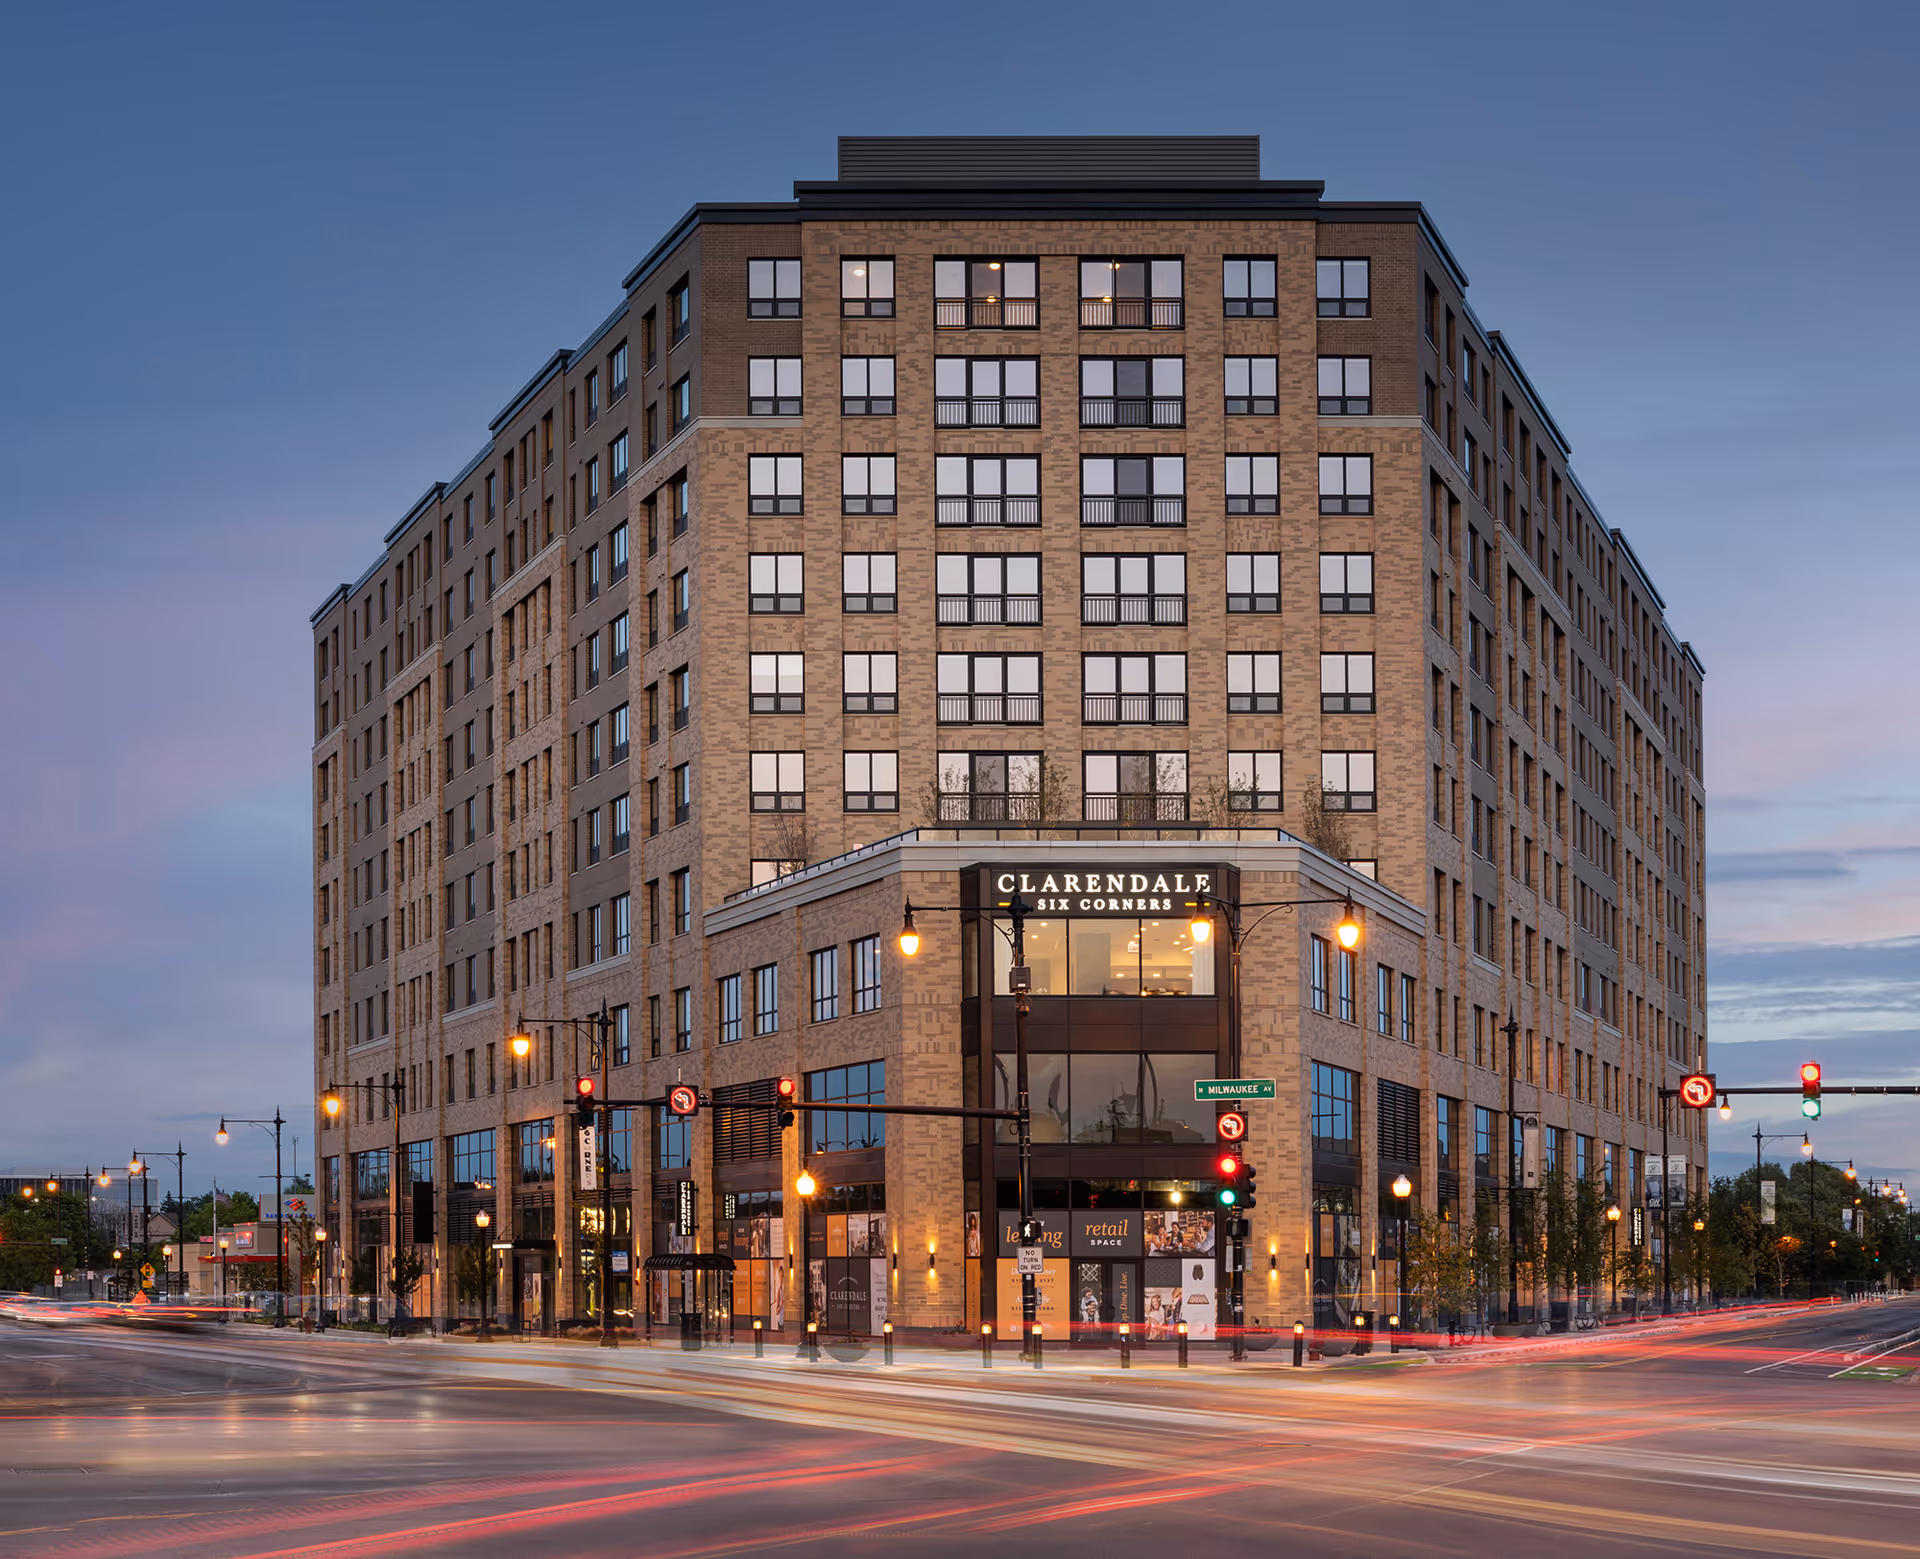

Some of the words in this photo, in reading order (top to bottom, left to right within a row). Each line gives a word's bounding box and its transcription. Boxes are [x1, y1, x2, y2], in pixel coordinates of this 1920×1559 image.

[997, 873, 1211, 893] CLARENDALE
[1037, 898, 1070, 910] SIX
[1079, 898, 1172, 911] CORNERS
[1208, 1084, 1259, 1095] MILWAUKEE
[1085, 1219, 1128, 1236] retail
[1006, 1225, 1063, 1248] leng
[829, 1290, 867, 1302] CLARENDALE
